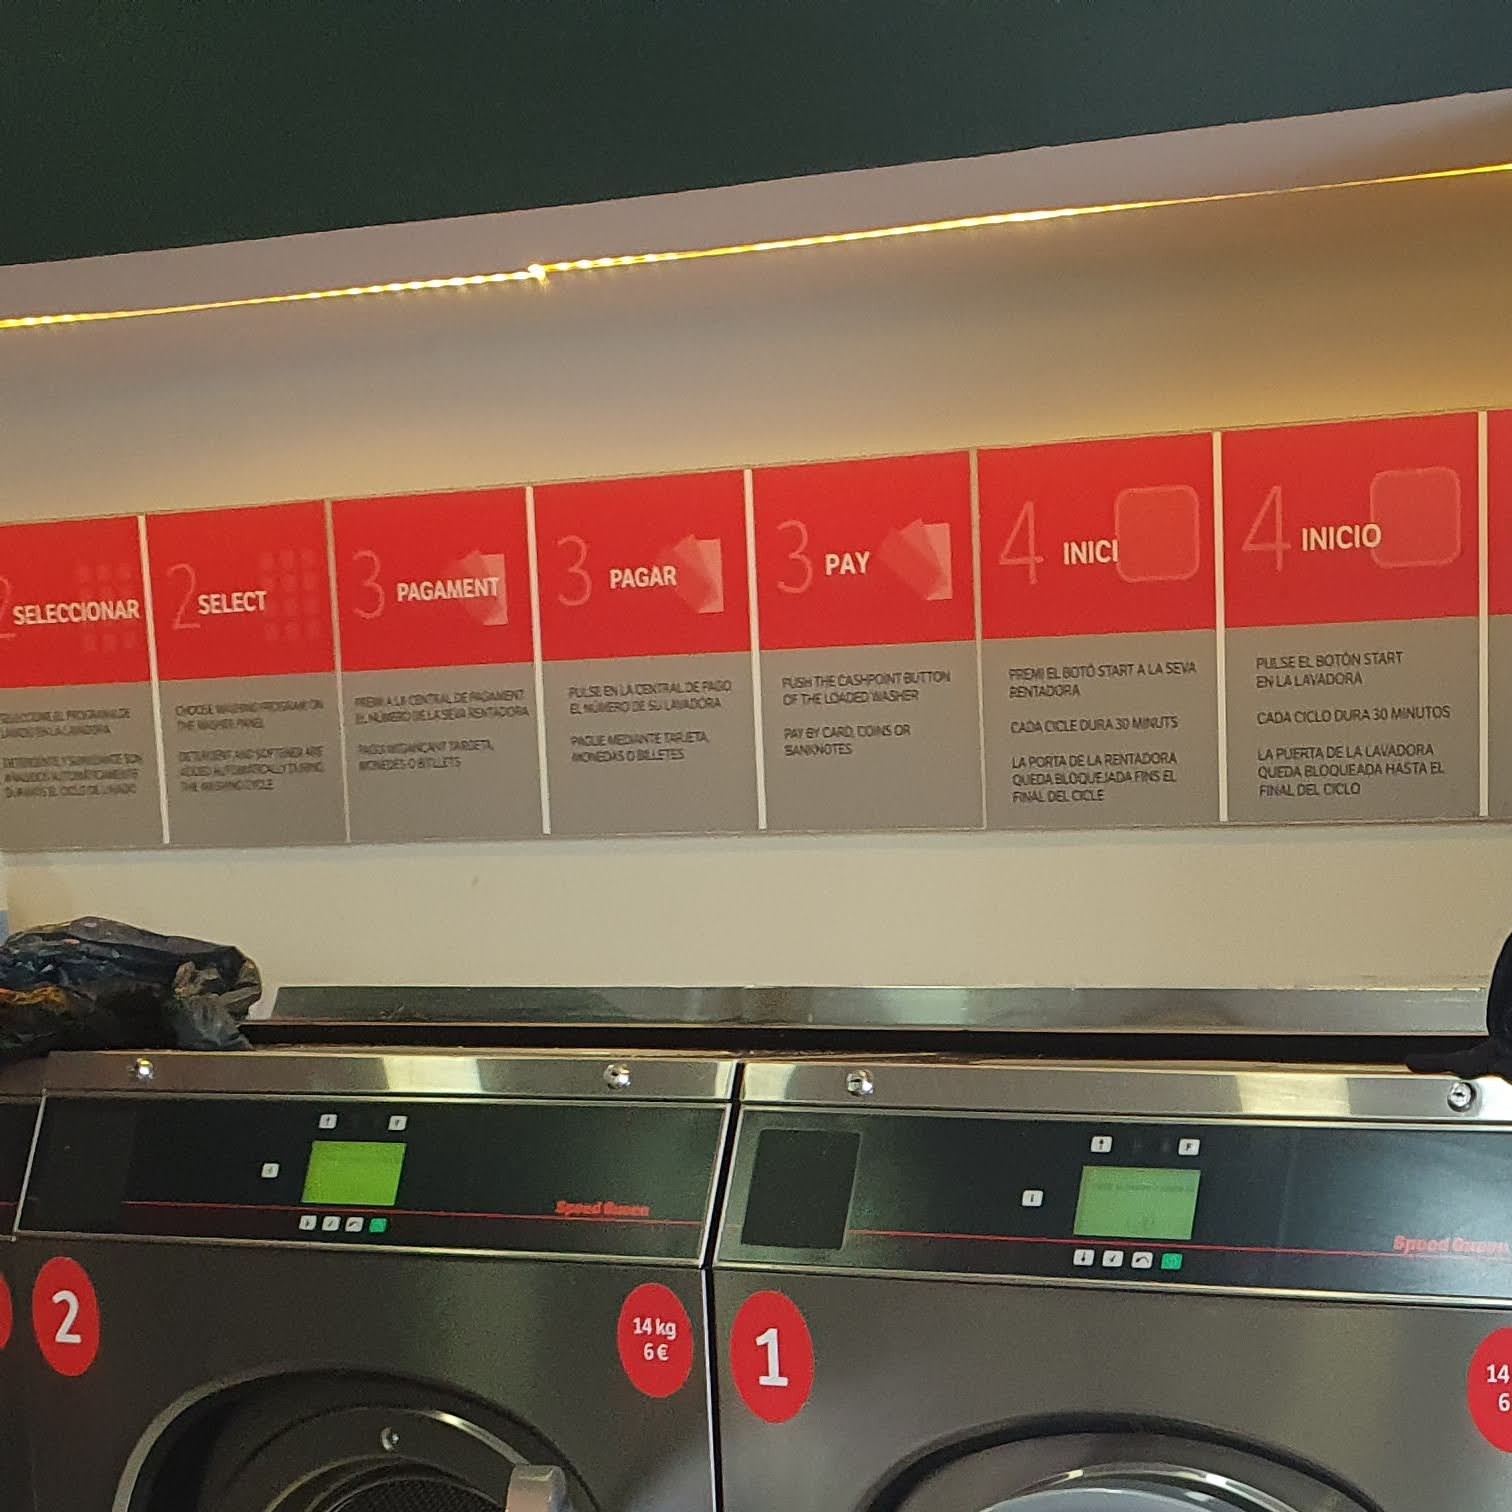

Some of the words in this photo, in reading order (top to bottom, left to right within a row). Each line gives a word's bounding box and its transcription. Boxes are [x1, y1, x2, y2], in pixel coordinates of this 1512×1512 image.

[1242, 485, 1291, 573] 4
[1301, 521, 1382, 551] INICIO
[1000, 500, 1044, 584] 4
[1063, 538, 1119, 565] INICI
[777, 519, 813, 594] 3
[825, 551, 870, 576] PAY
[557, 534, 592, 606] 3
[609, 565, 677, 589] PAGAR
[352, 549, 385, 620] 3
[397, 576, 499, 601] PAGAMENT
[167, 563, 200, 629] 2
[198, 590, 267, 615] SELECT
[13, 599, 139, 625] SELECCIONAR
[1256, 656, 1295, 669] PULSE
[1298, 655, 1314, 668] EL
[1316, 651, 1361, 668] BOTÓN
[1364, 651, 1404, 665] START
[782, 676, 812, 689] PUSH
[814, 674, 835, 687] THE
[837, 672, 901, 686] CASHPOINT
[903, 671, 952, 684] BUTTON
[1047, 667, 1062, 680] EL
[1098, 664, 1134, 678] START
[1137, 663, 1146, 676] A
[1148, 662, 1163, 676] LA
[1166, 661, 1196, 675] SEVA
[1256, 675, 1274, 688] EN
[1276, 675, 1292, 687] LA
[1294, 671, 1363, 687] LAVADORA
[782, 693, 798, 706] OF
[800, 692, 821, 705] THE
[825, 690, 869, 705] LOADED
[871, 689, 920, 702] WASHER
[1009, 684, 1081, 698] RENTADORA
[1010, 720, 1044, 734] CADA
[1080, 717, 1114, 732] DURA
[1116, 717, 1130, 730] 30
[1132, 715, 1178, 730] MINUTS
[1257, 711, 1292, 725] CADA
[1294, 709, 1332, 724] CICLO
[1334, 708, 1371, 722] DURA
[1373, 707, 1388, 721] 30
[1390, 705, 1451, 720] MINUTOS
[784, 727, 803, 739] PAY
[805, 727, 820, 739] BY
[894, 724, 912, 736] OR
[783, 743, 854, 757] BANKNOTES
[1258, 748, 1274, 761] LA
[1276, 746, 1324, 761] PUERTA
[1326, 746, 1343, 759] DE
[1346, 745, 1362, 759] LA
[1365, 743, 1434, 758] LAVADORA
[1012, 756, 1026, 769] LA
[1029, 754, 1067, 768] PORTA
[1069, 754, 1085, 767] DE
[1087, 753, 1102, 766] LA
[1104, 752, 1177, 766] RENTADORA
[1258, 765, 1302, 779] QUEDA
[1304, 763, 1383, 778] BLOQUEADA
[1385, 761, 1427, 776] HASTA
[1430, 761, 1445, 774] EL
[1012, 773, 1053, 787] QUEDA
[1135, 769, 1161, 783] FINS
[1163, 769, 1177, 782] EL
[1012, 790, 1045, 803] FINAL
[1047, 789, 1071, 802] DEL
[1072, 788, 1104, 801] CICLE
[1259, 784, 1294, 797] FINAL
[1297, 783, 1320, 796] DEL
[1323, 781, 1361, 795] CICLO
[52, 1289, 82, 1344] 2
[633, 1317, 652, 1336] 14
[656, 1318, 677, 1340] kg
[643, 1342, 654, 1361] 6
[756, 1328, 789, 1387] 1
[1486, 1364, 1510, 1384] 14
[1498, 1392, 1511, 1412] 6
